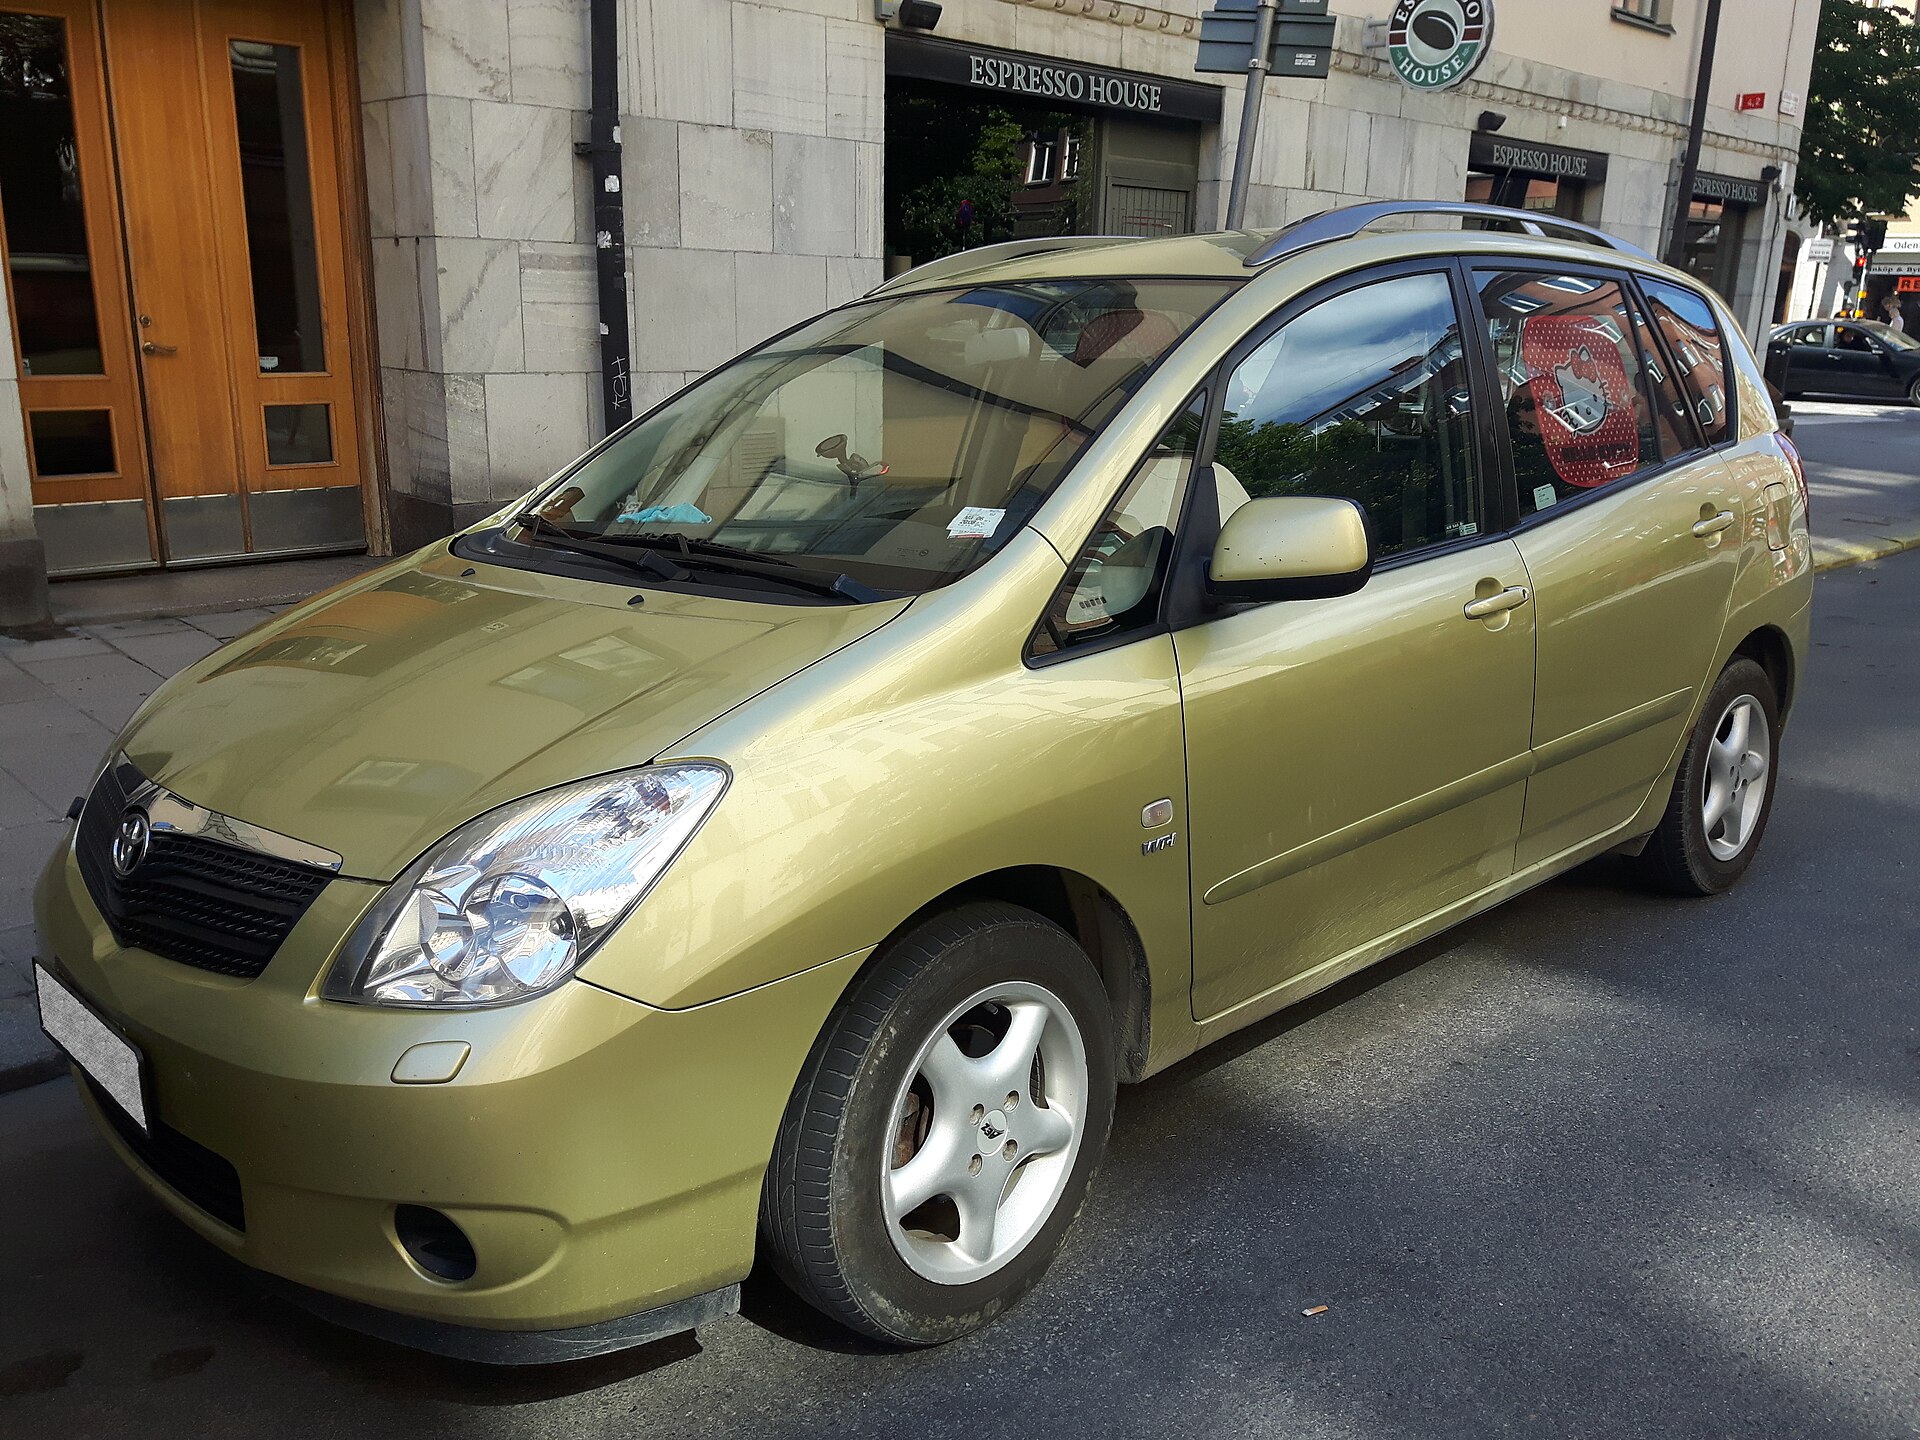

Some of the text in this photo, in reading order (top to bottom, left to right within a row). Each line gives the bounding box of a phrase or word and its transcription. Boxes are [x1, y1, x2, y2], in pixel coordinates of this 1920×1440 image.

[969, 55, 1161, 112] ESPRESSO HOUSE
[1399, 55, 1464, 84] HOUSE
[1493, 144, 1588, 177] ESPRESSO HOUSE
[1731, 183, 1758, 202] HOUSE
